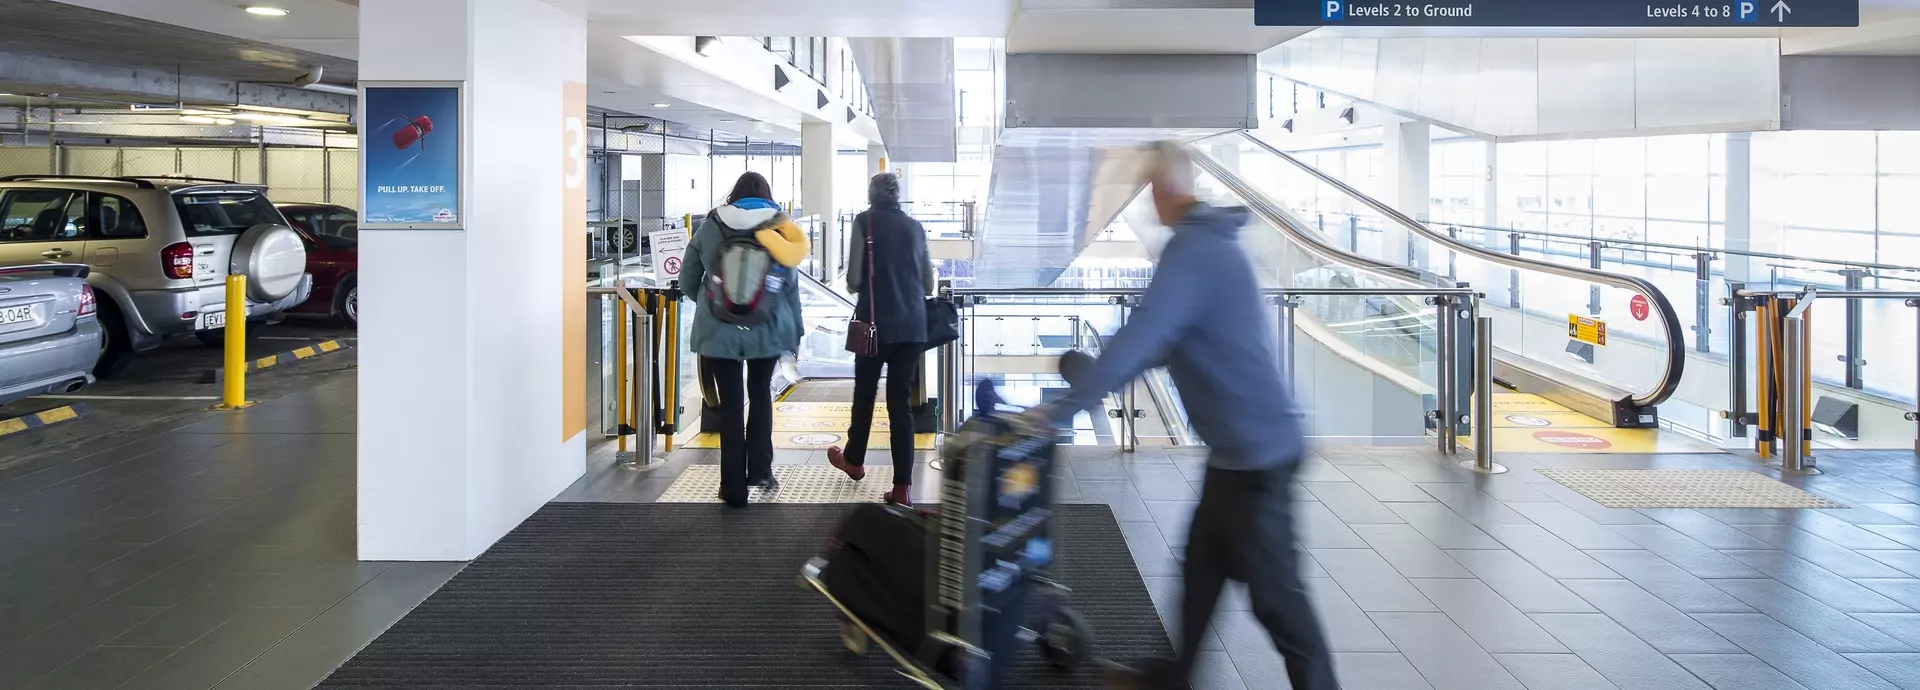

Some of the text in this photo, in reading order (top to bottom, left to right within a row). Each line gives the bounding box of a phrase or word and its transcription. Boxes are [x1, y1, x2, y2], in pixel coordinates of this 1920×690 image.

[1349, 4, 1390, 17] Levels
[1393, 4, 1401, 17] 2
[1406, 5, 1420, 17] to
[1423, 4, 1472, 17] Ground
[1647, 4, 1688, 18] Levels
[1691, 5, 1700, 18] 4
[1704, 5, 1718, 18] to
[1722, 5, 1731, 18] 8
[565, 116, 585, 190] 3
[377, 185, 446, 193] PULL UP. TAKE OFF.
